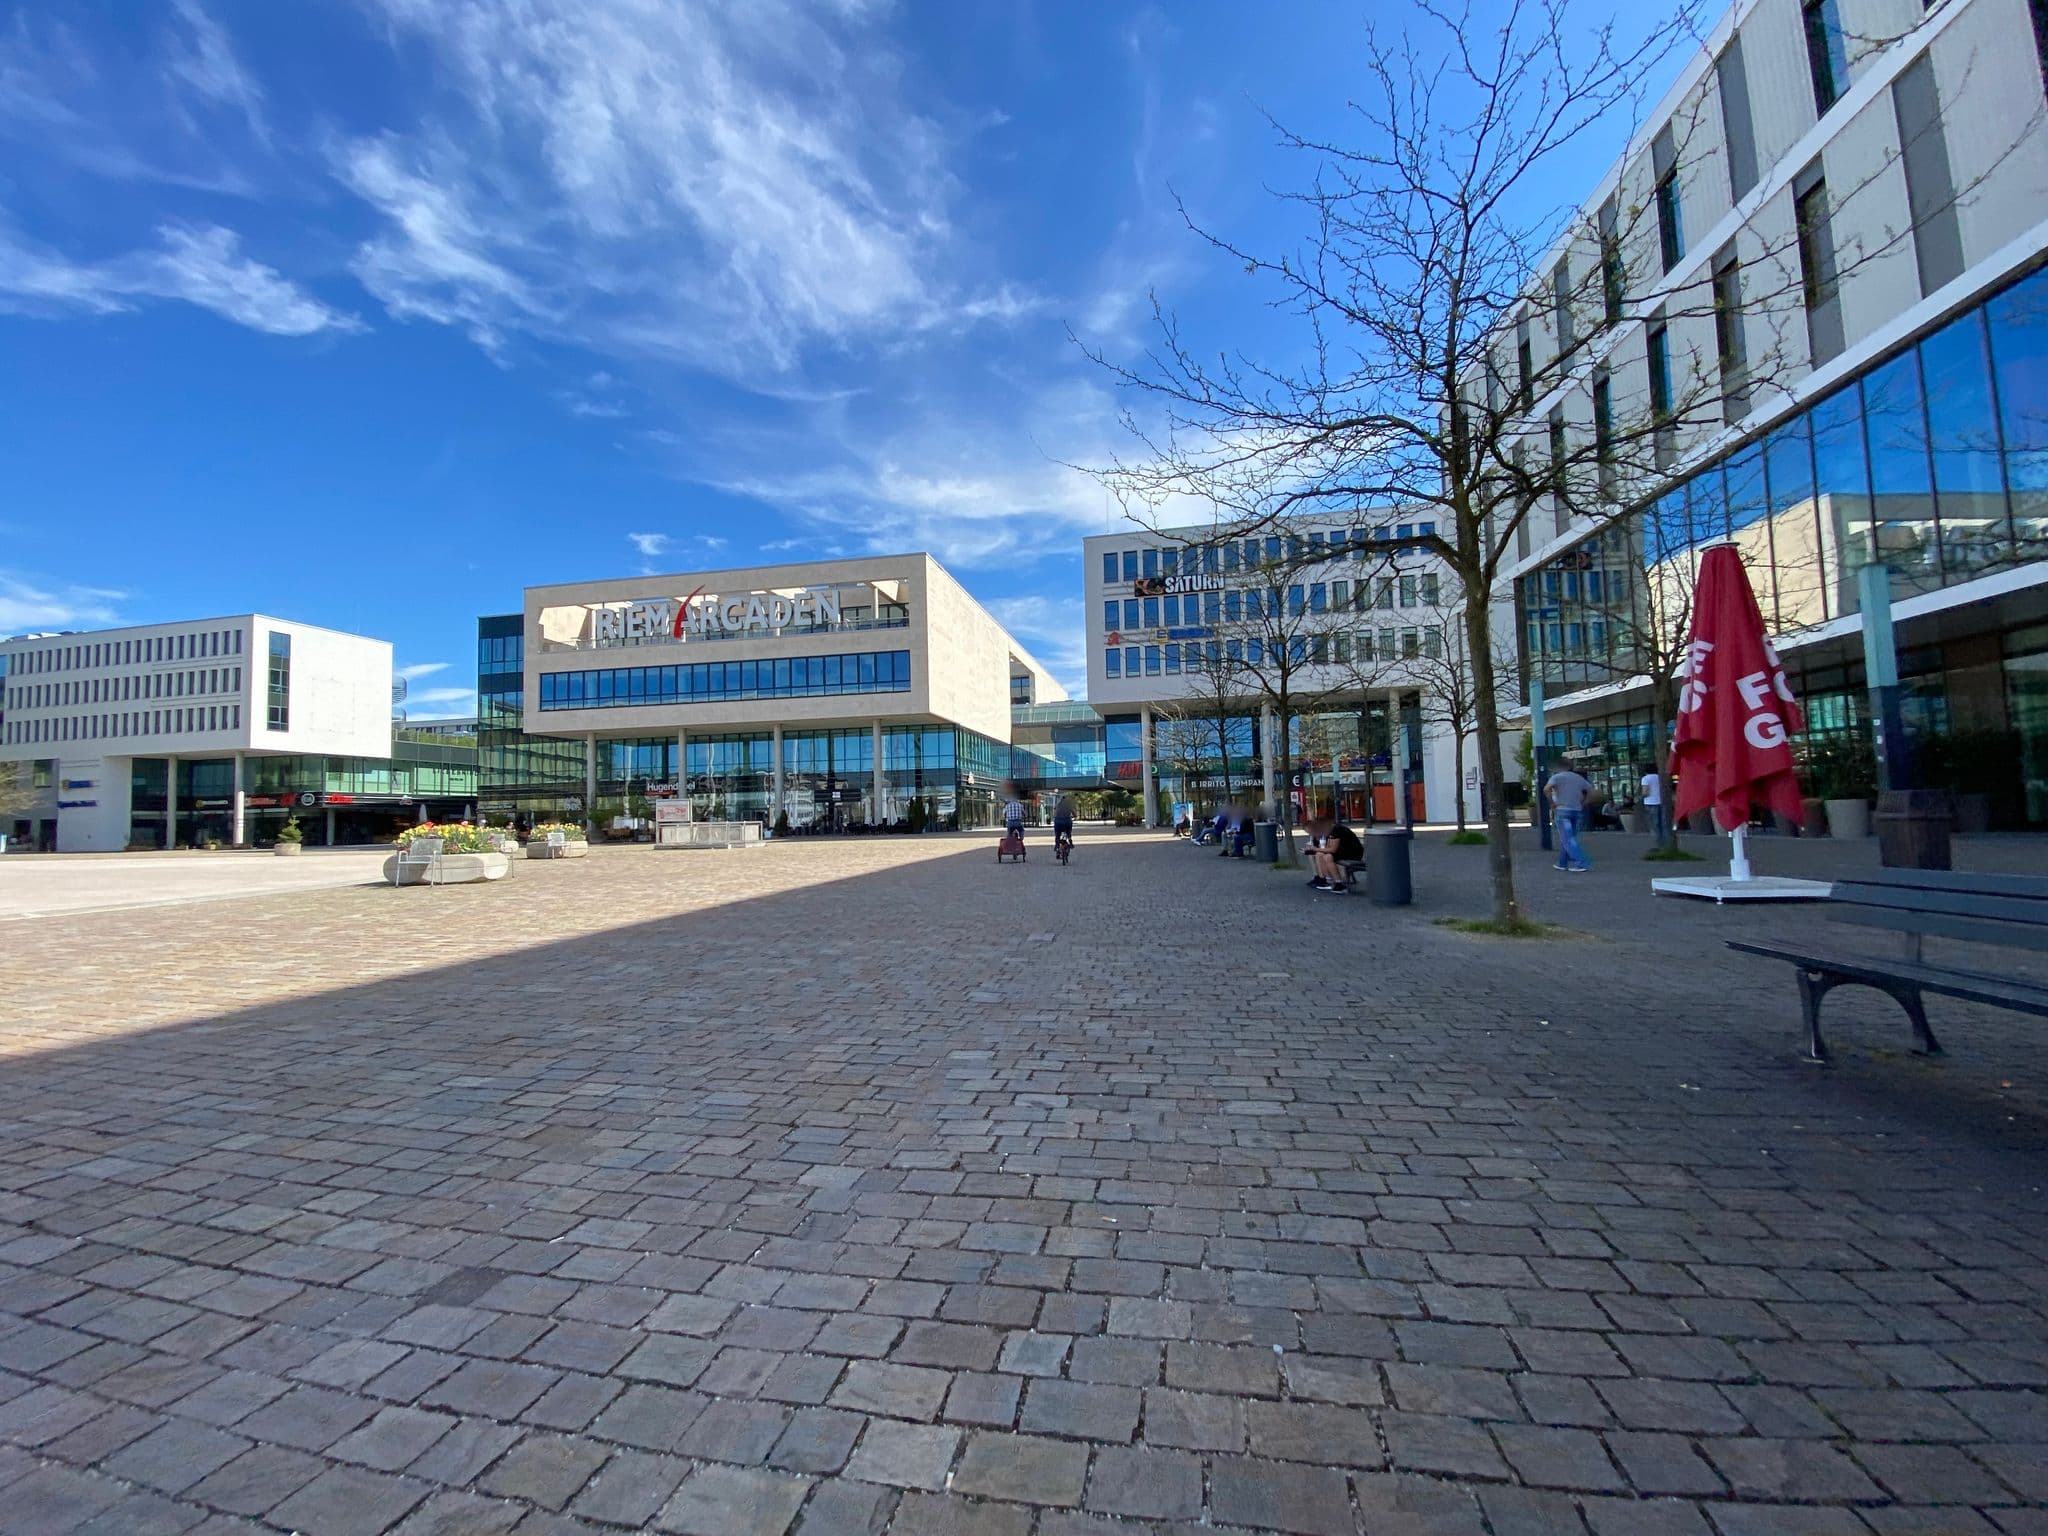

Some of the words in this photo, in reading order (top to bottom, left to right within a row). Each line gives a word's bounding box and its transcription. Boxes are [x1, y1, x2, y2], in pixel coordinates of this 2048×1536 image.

[1164, 573, 1226, 594] SATURN
[596, 603, 672, 640] RIEM
[673, 584, 841, 639] ARCADEN
[647, 781, 696, 793] Hugendel
[1228, 779, 1264, 787] COMPAN
